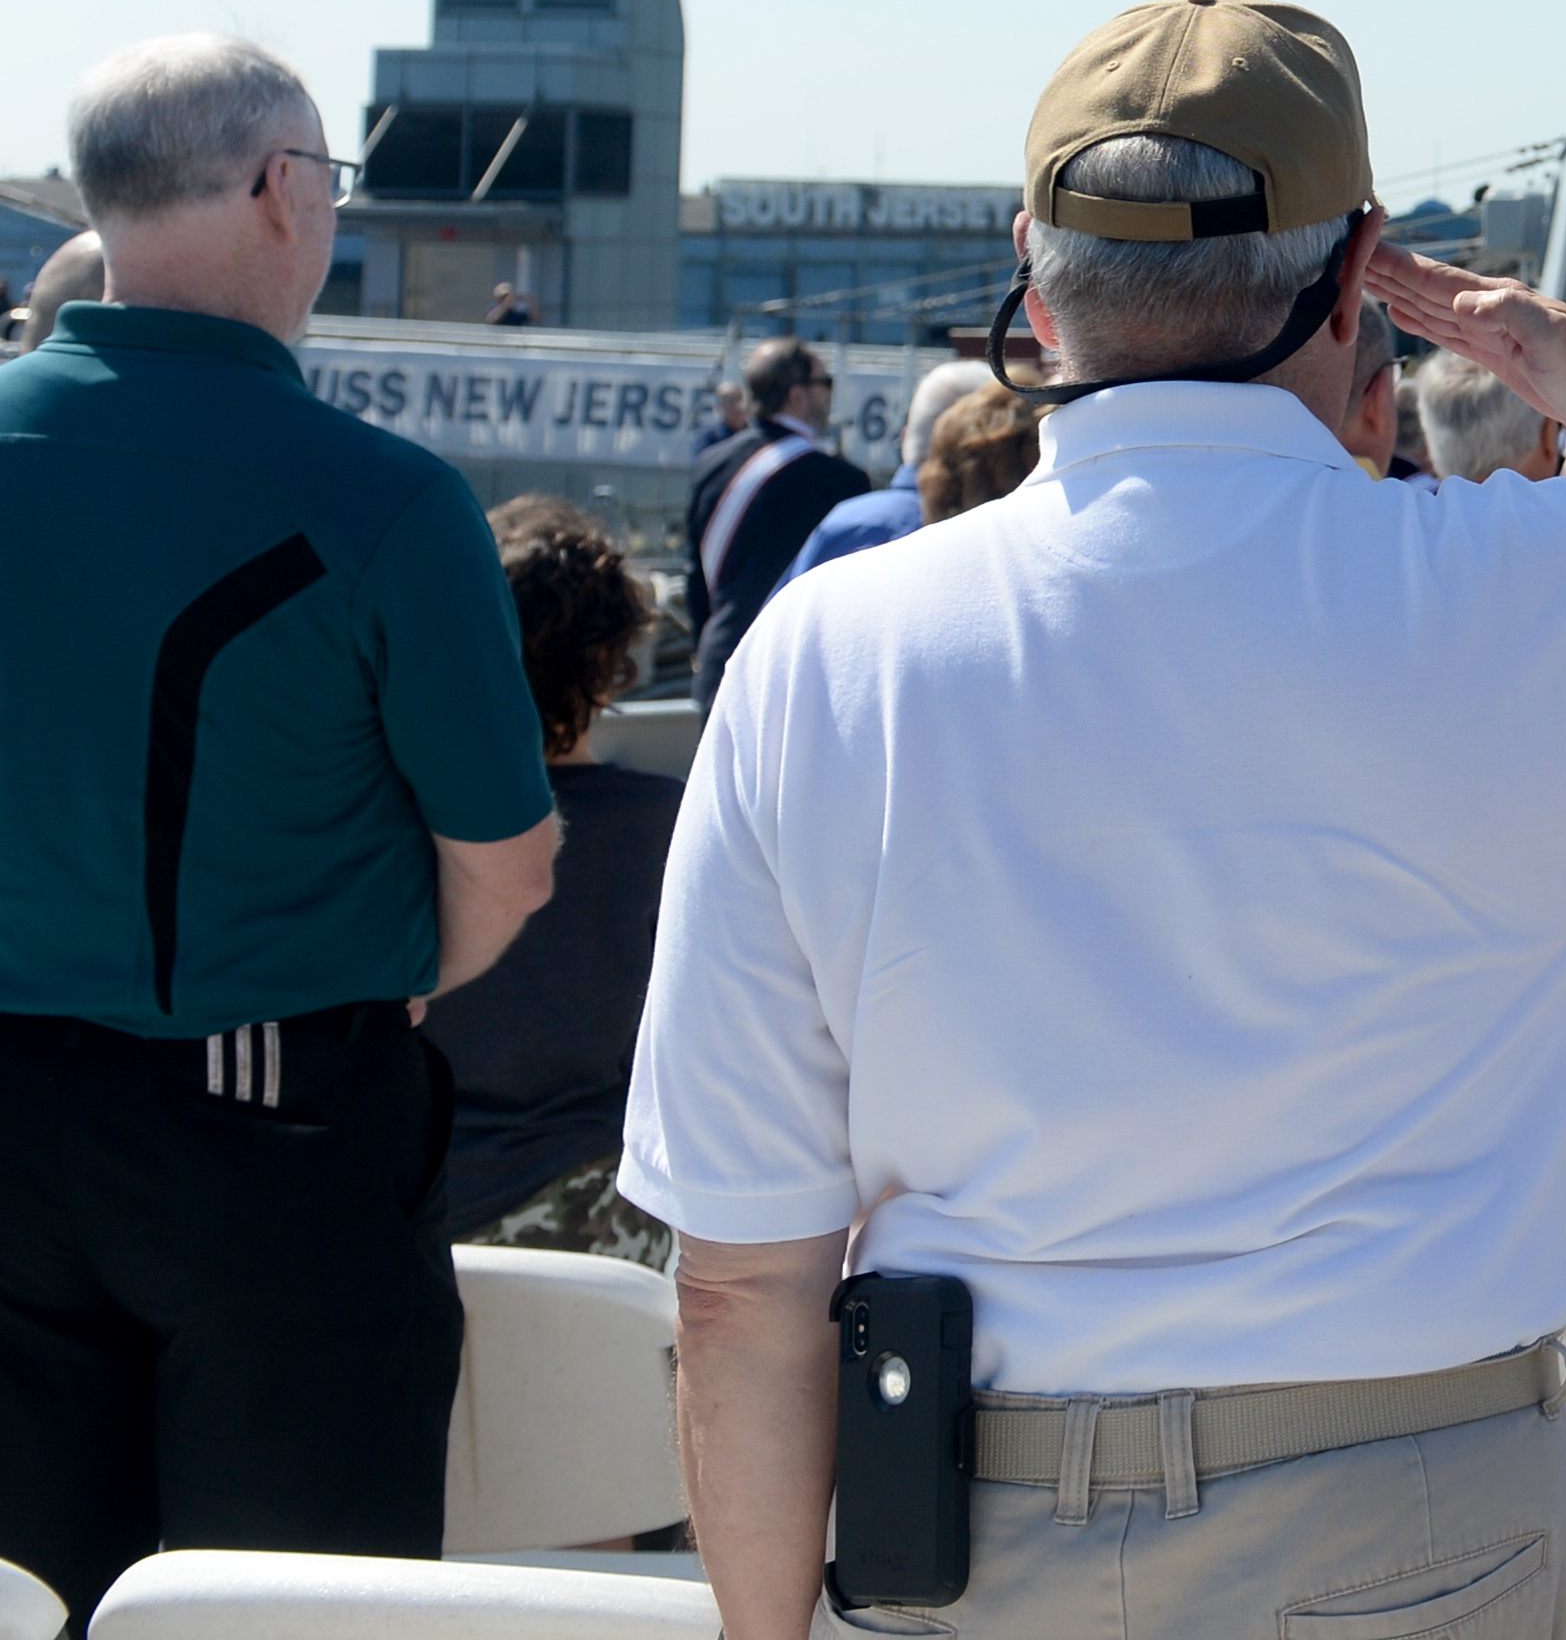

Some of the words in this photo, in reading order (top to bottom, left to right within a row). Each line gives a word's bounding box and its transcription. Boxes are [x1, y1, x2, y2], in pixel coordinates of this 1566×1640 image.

[722, 185, 859, 227] SOUTH
[866, 187, 1014, 228] JERSEY
[309, 367, 407, 416] USS
[425, 372, 541, 421] NEW
[554, 379, 714, 430] JERSE
